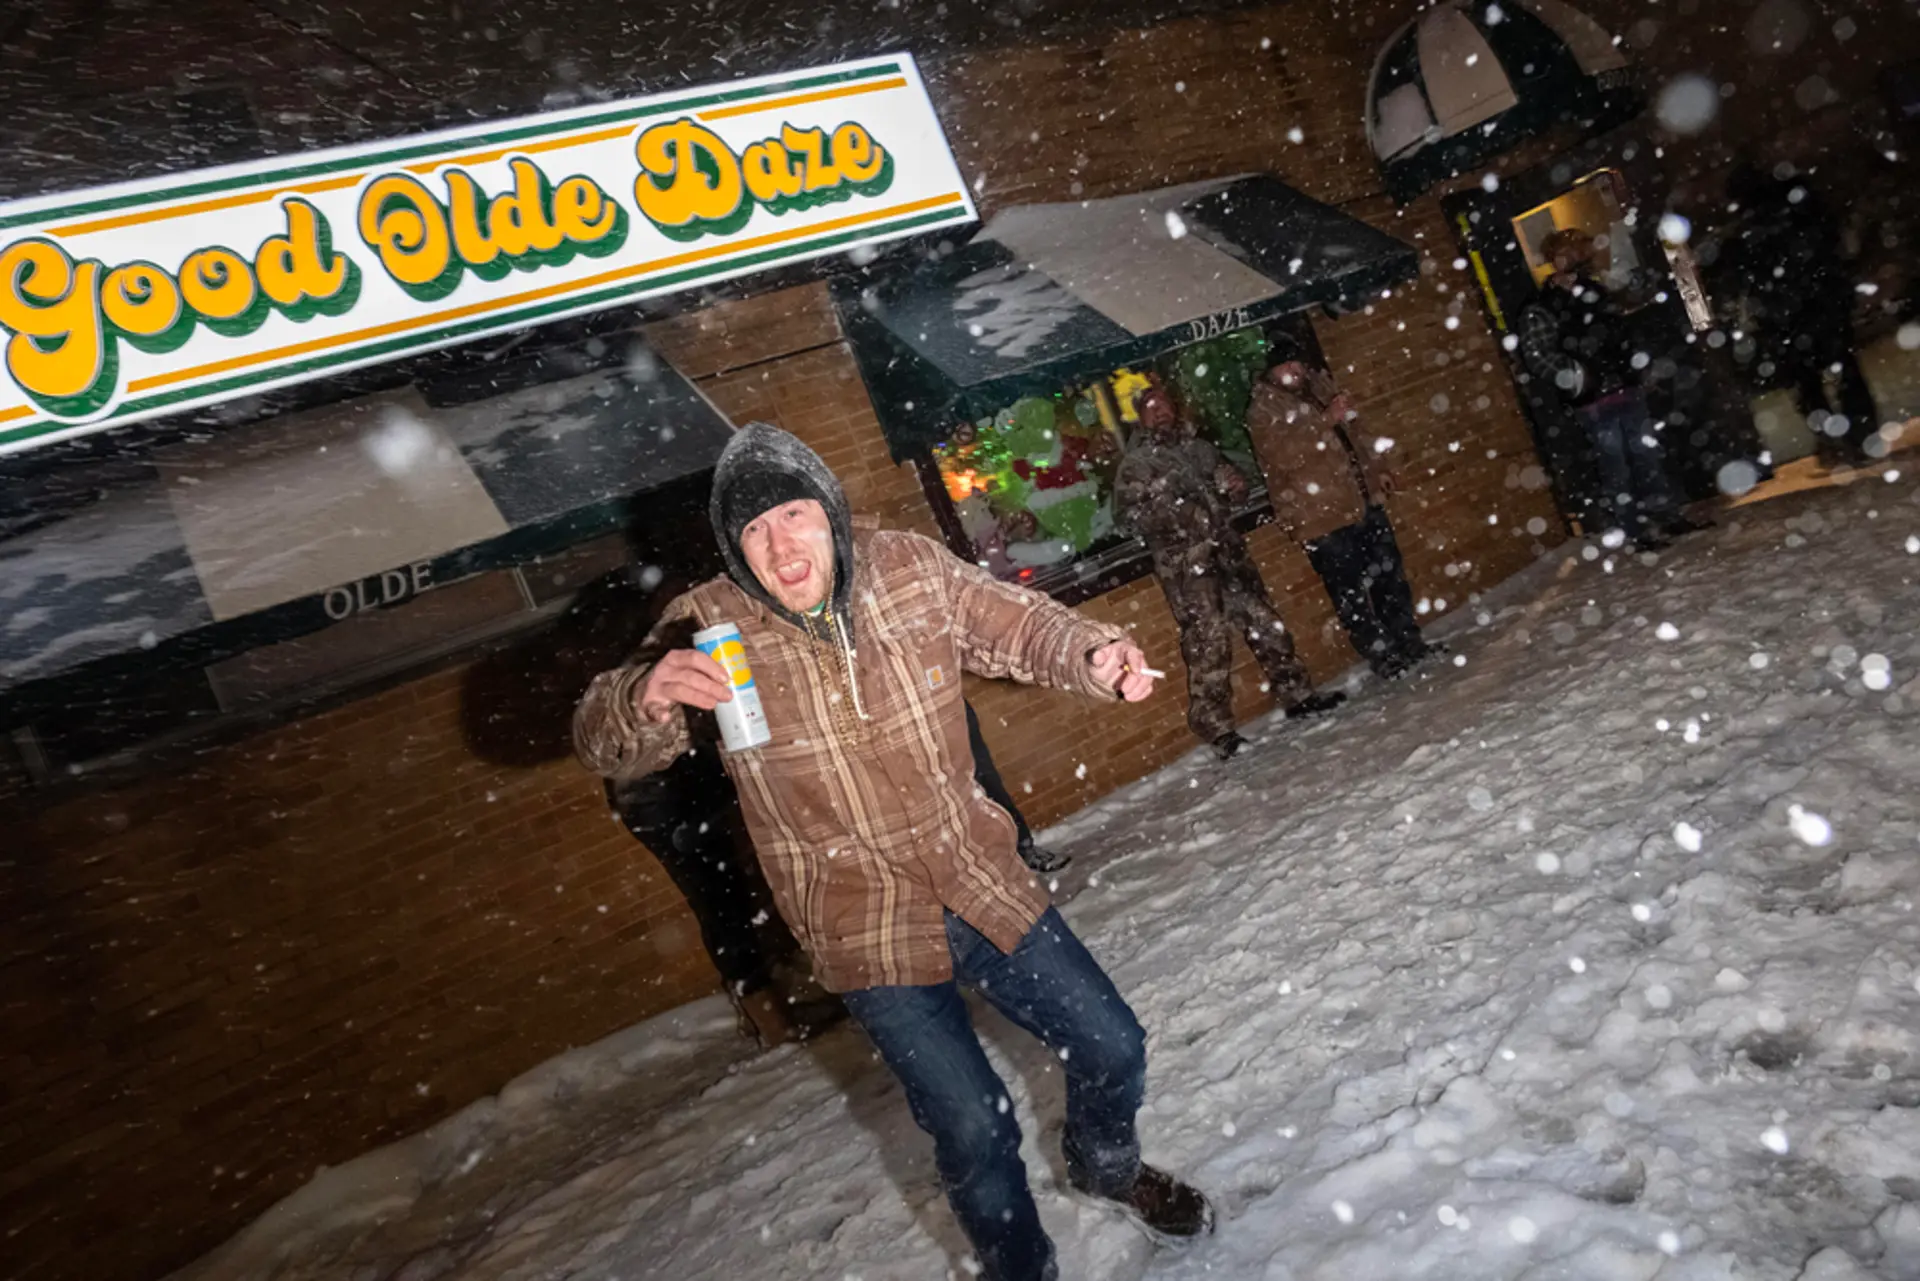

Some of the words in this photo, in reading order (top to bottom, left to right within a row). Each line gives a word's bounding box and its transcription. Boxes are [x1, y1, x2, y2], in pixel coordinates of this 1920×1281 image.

[0, 197, 362, 417] Good
[357, 157, 629, 302] Olde
[634, 117, 895, 242] Daze
[1190, 307, 1250, 341] DAZE
[323, 559, 435, 620] OLDE
